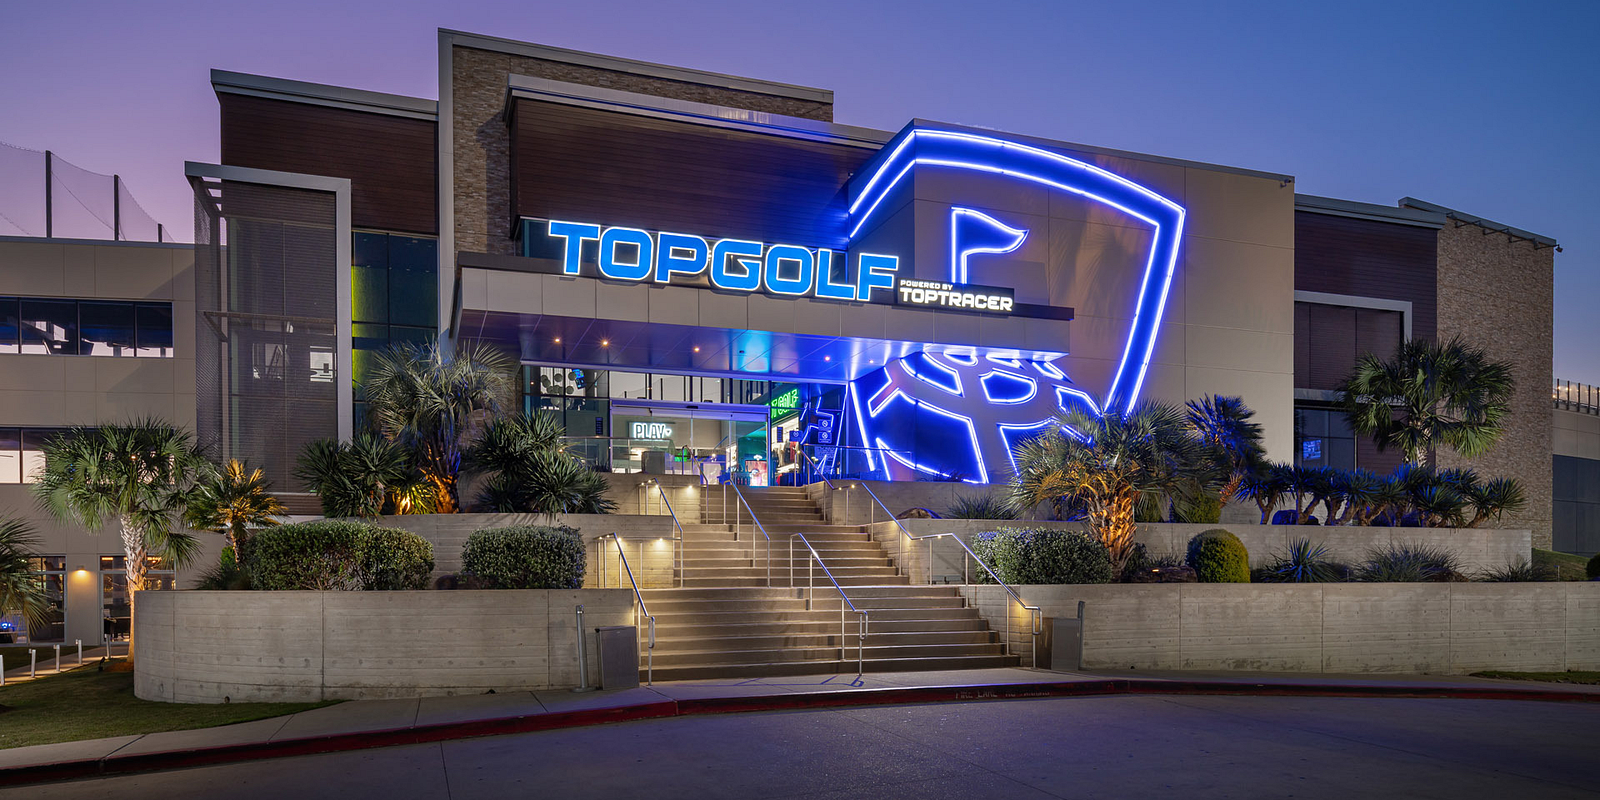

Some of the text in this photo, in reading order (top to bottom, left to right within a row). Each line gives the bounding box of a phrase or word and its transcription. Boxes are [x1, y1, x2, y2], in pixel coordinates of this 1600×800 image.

[548, 219, 899, 302] TOPGOLF
[900, 279, 953, 291] POWERED BY
[900, 287, 1013, 311] TOPTRACER
[634, 422, 666, 439] PLAY
